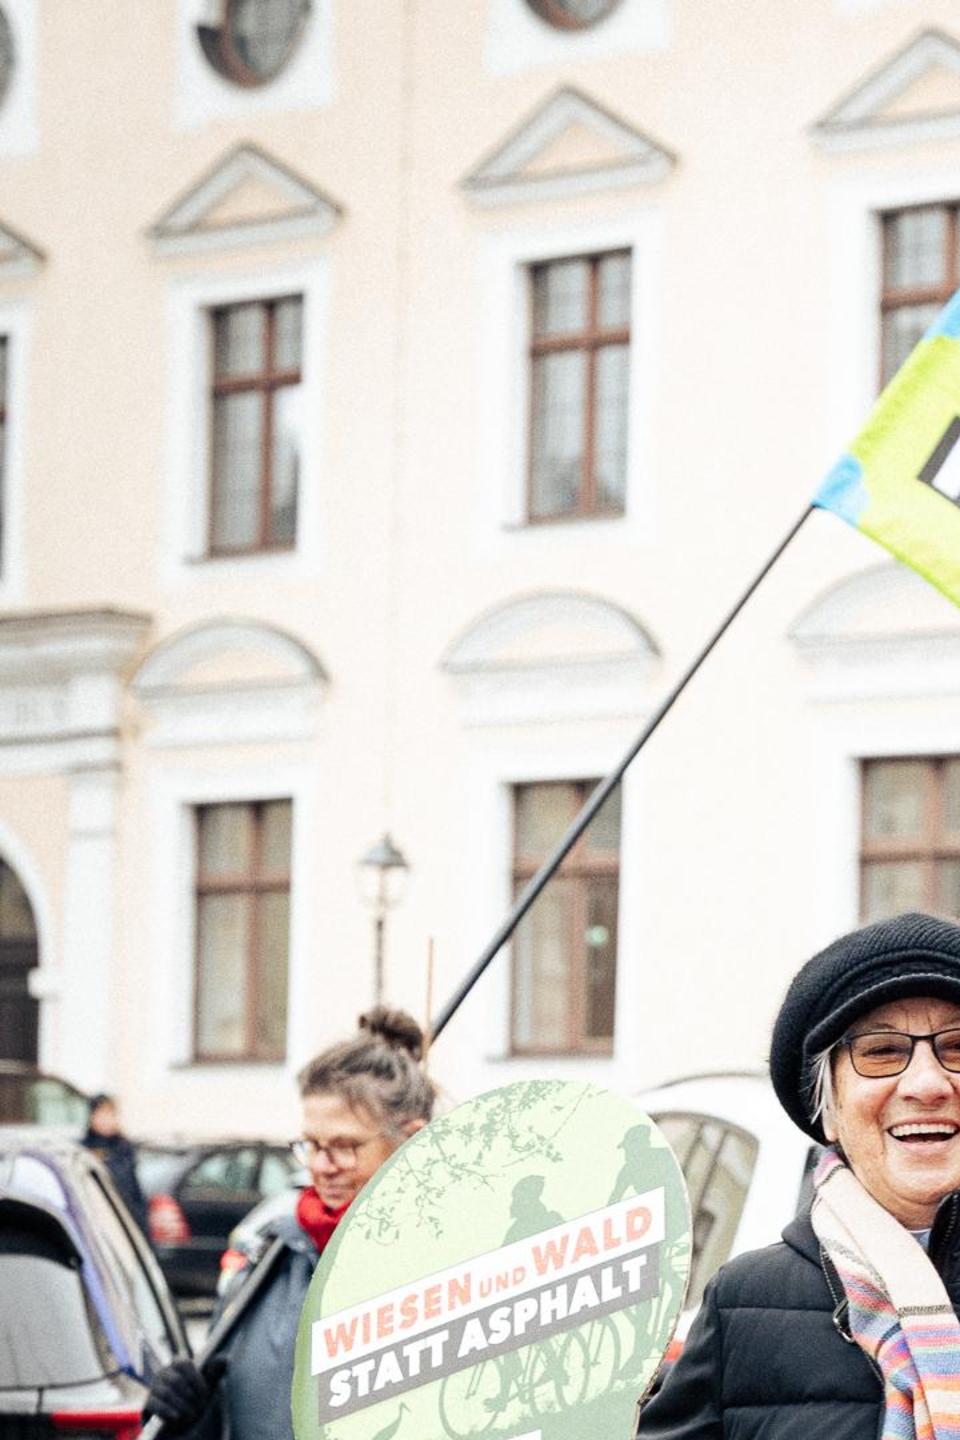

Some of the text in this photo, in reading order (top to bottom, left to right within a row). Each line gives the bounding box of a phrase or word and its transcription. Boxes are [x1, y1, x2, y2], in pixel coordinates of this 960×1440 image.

[322, 1206, 653, 1358] WIESEN UND WALD
[328, 1255, 647, 1408] STATT ASPHALT
